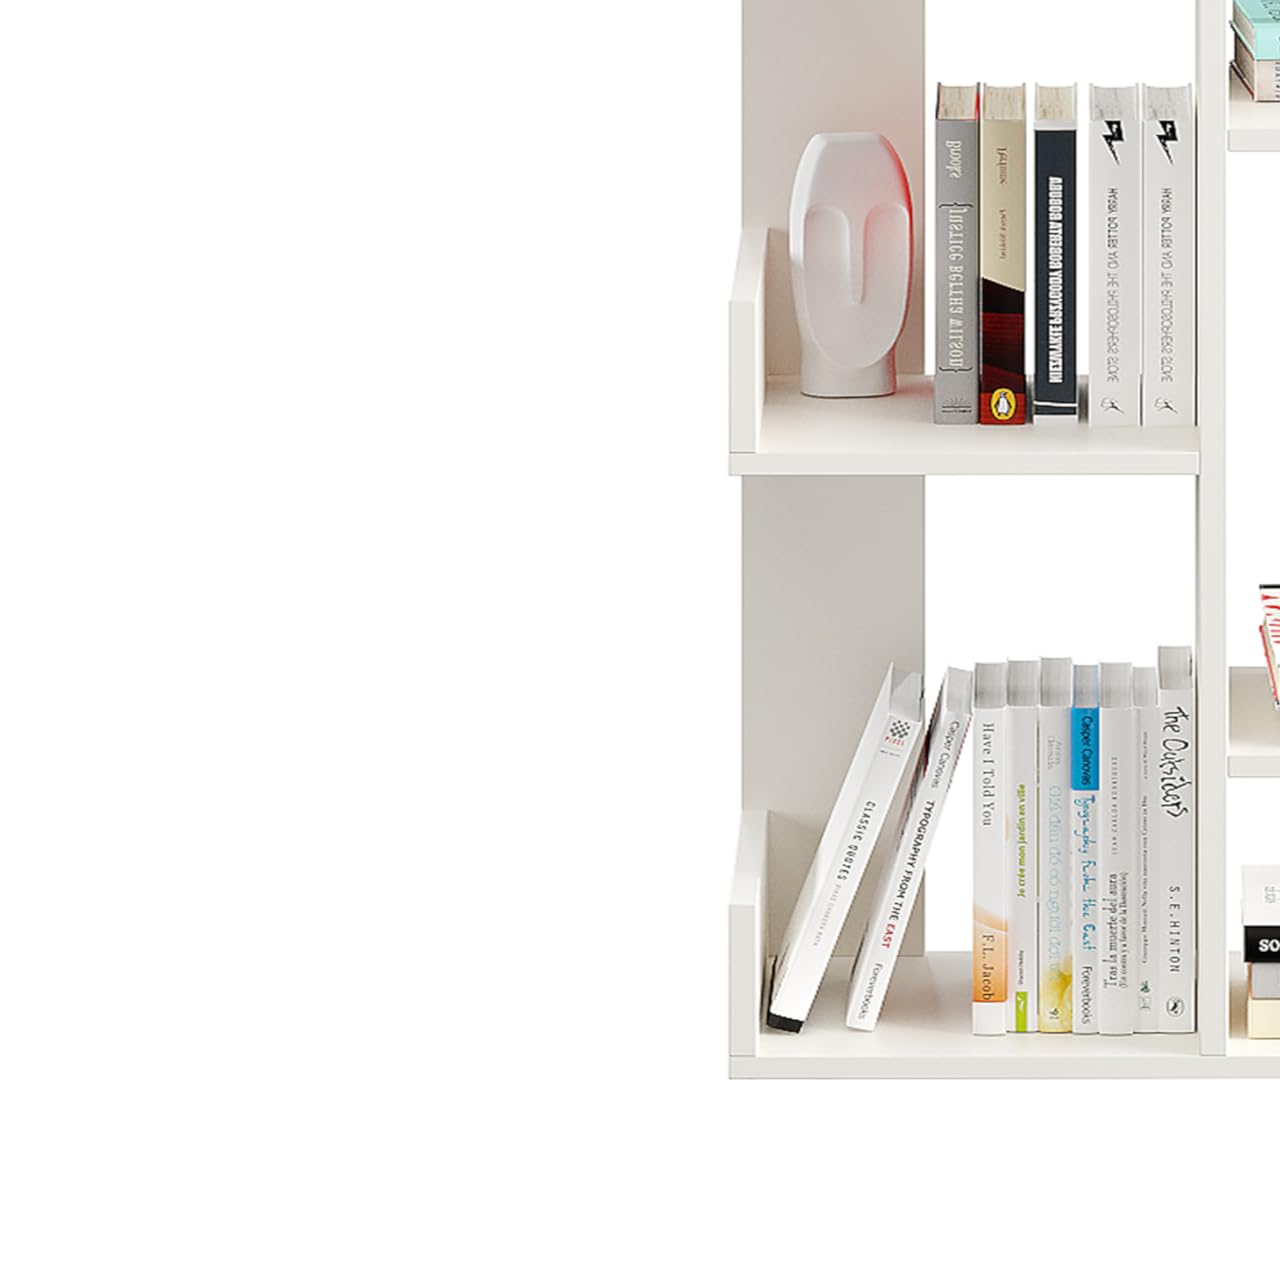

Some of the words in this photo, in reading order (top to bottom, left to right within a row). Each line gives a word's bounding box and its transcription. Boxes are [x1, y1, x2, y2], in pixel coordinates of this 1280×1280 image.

[1080, 715, 1095, 747] Casper
[1162, 706, 1190, 733] The
[982, 722, 996, 756] Have
[1081, 748, 1094, 787] Canovas
[1159, 739, 1192, 818] Outsiders
[982, 768, 997, 798] Told
[852, 800, 877, 842] CLASSIC
[982, 801, 996, 827] You
[903, 800, 936, 869] TYPOGRAPHY
[837, 844, 860, 882] QUOTES
[896, 869, 914, 899] FROM
[888, 902, 904, 921] THE
[1102, 898, 1118, 914] del
[881, 923, 897, 949] EAST
[981, 933, 996, 961] F.L.
[1102, 953, 1118, 964] la
[981, 963, 997, 1002] Jacob
[1103, 965, 1118, 989] Tras
[1080, 965, 1094, 1025] Foreverbooks
